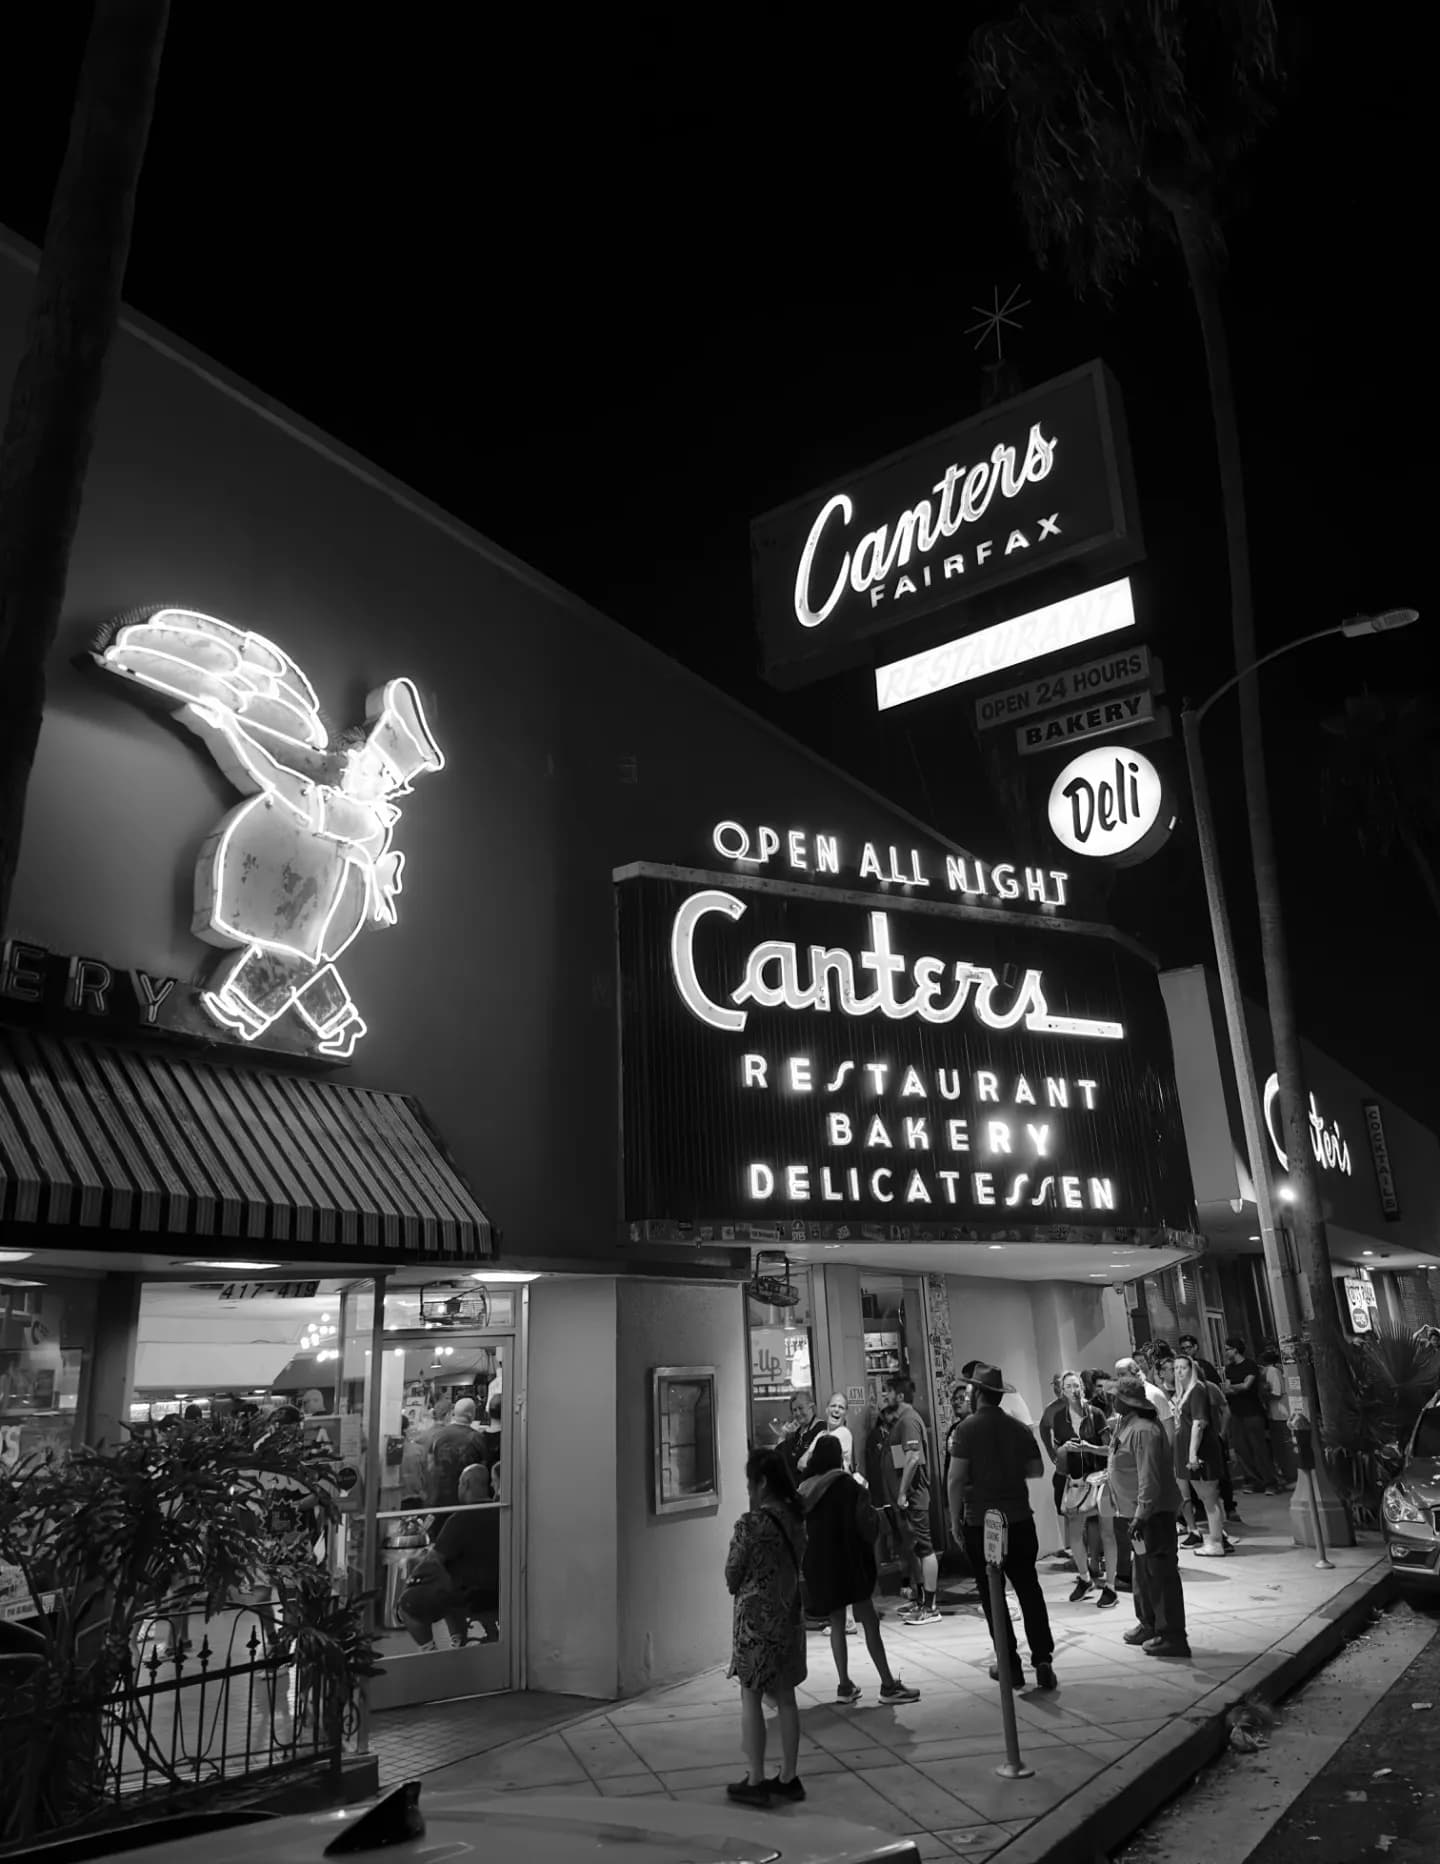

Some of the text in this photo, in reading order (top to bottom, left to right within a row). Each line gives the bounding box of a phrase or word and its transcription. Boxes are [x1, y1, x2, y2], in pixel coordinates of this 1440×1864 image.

[870, 512, 1062, 608] FAIRFAX
[882, 588, 1121, 704] RESTAURANT
[981, 654, 1142, 722] OPEN 24 HOURS
[1026, 696, 1142, 746] BAKERY
[1062, 757, 1140, 843] Deli
[712, 820, 1069, 906] OPEN ALL NIGHT
[742, 1053, 1097, 1109] RESTAURANT
[827, 1112, 1050, 1156] BAKERY
[749, 1163, 1116, 1210] DELICATESSEN
